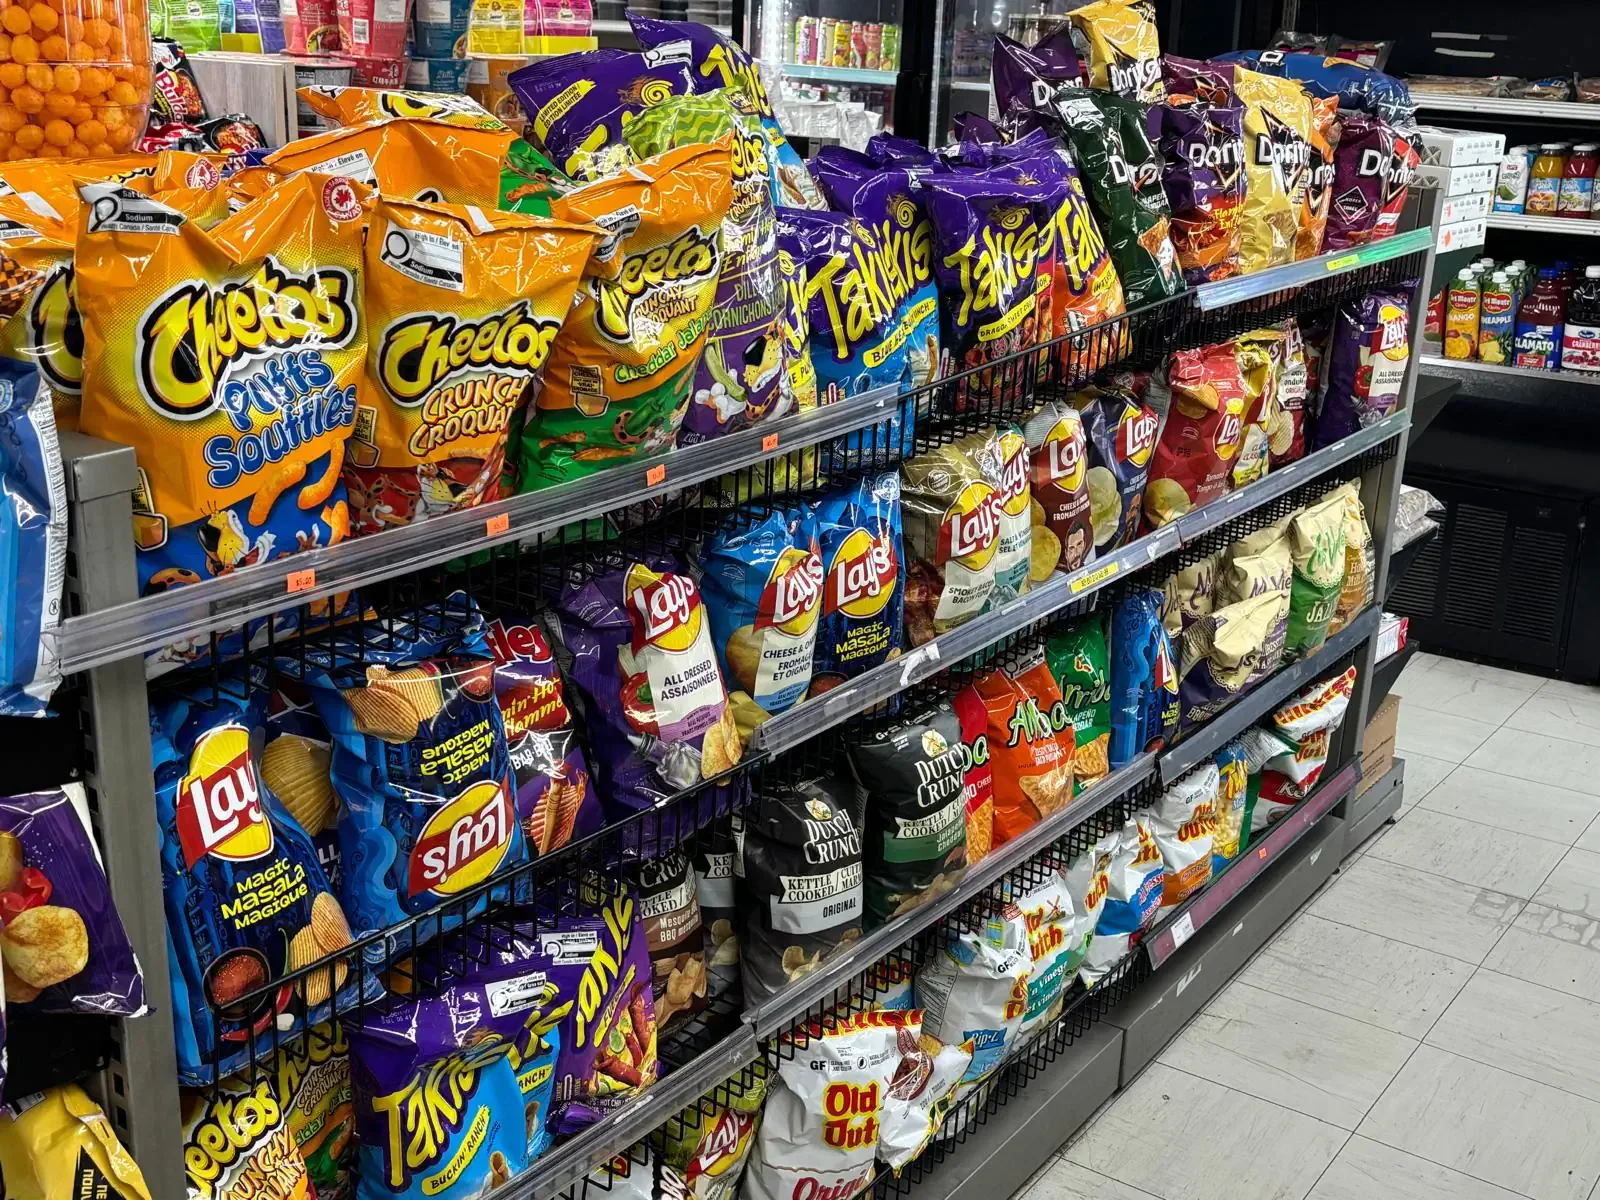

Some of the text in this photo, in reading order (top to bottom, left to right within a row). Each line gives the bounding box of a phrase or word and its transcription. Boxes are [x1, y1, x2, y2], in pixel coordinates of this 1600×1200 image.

[557, 84, 578, 105] EDITION
[125, 213, 153, 222] Sodium
[410, 260, 434, 275] Sodium
[142, 260, 352, 414] Cheetos
[1515, 338, 1555, 351] CLAMATO
[380, 301, 559, 398] Cheetos
[614, 344, 677, 384] Cheddar
[204, 384, 356, 488] Soufflés
[763, 646, 798, 659] CHEESE
[663, 659, 713, 687] ALL DRESSED
[773, 672, 784, 681] ET
[660, 669, 719, 702] ASSAISONNÉES
[804, 808, 852, 844] DUTCH
[903, 818, 947, 838] COOKED
[904, 809, 944, 828] KETTLE
[787, 874, 832, 891] KETTLE
[787, 885, 835, 902] COOKED
[822, 901, 857, 919] ORIGINAL
[660, 929, 677, 942] BBQ
[810, 1060, 826, 1071] GF
[826, 1083, 878, 1118] Old
[430, 1116, 487, 1190] BUCKIN' RANCH
